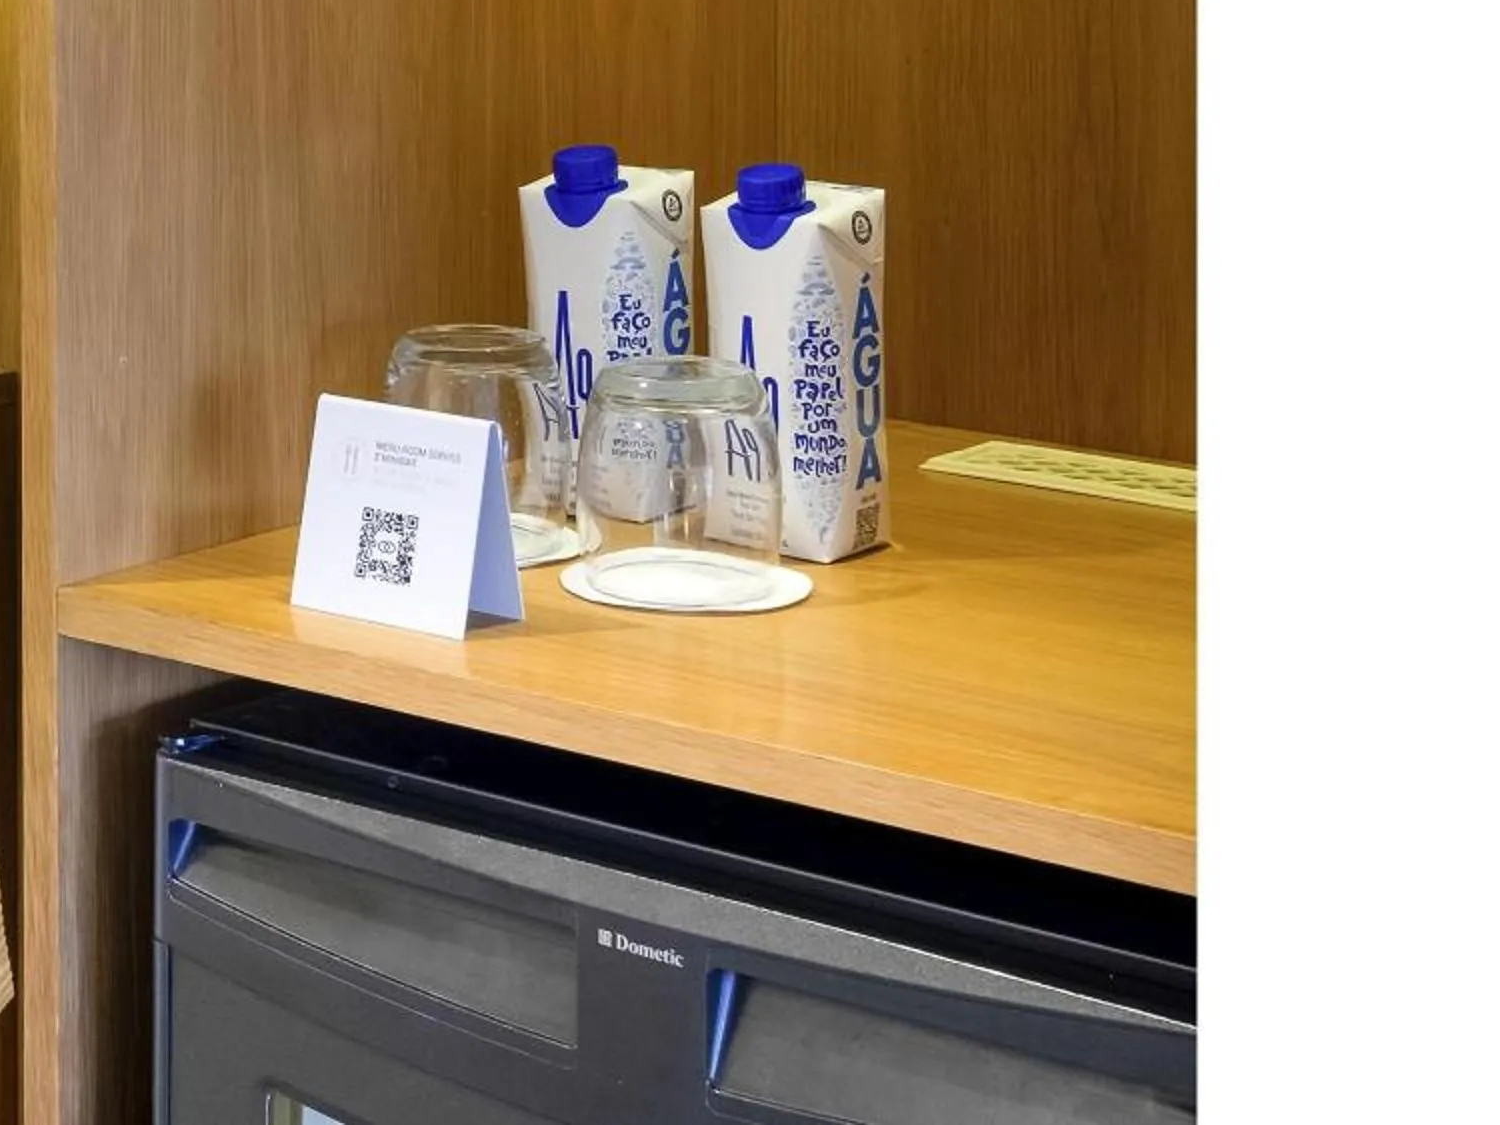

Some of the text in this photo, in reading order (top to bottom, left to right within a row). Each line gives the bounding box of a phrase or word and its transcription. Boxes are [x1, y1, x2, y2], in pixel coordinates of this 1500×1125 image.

[619, 294, 642, 311] Eu
[806, 320, 831, 338] Eu
[617, 334, 647, 349] meu
[798, 338, 840, 362] faço
[805, 363, 837, 377] meu
[852, 272, 881, 490] ÁGUA
[616, 933, 684, 968] Dometic
